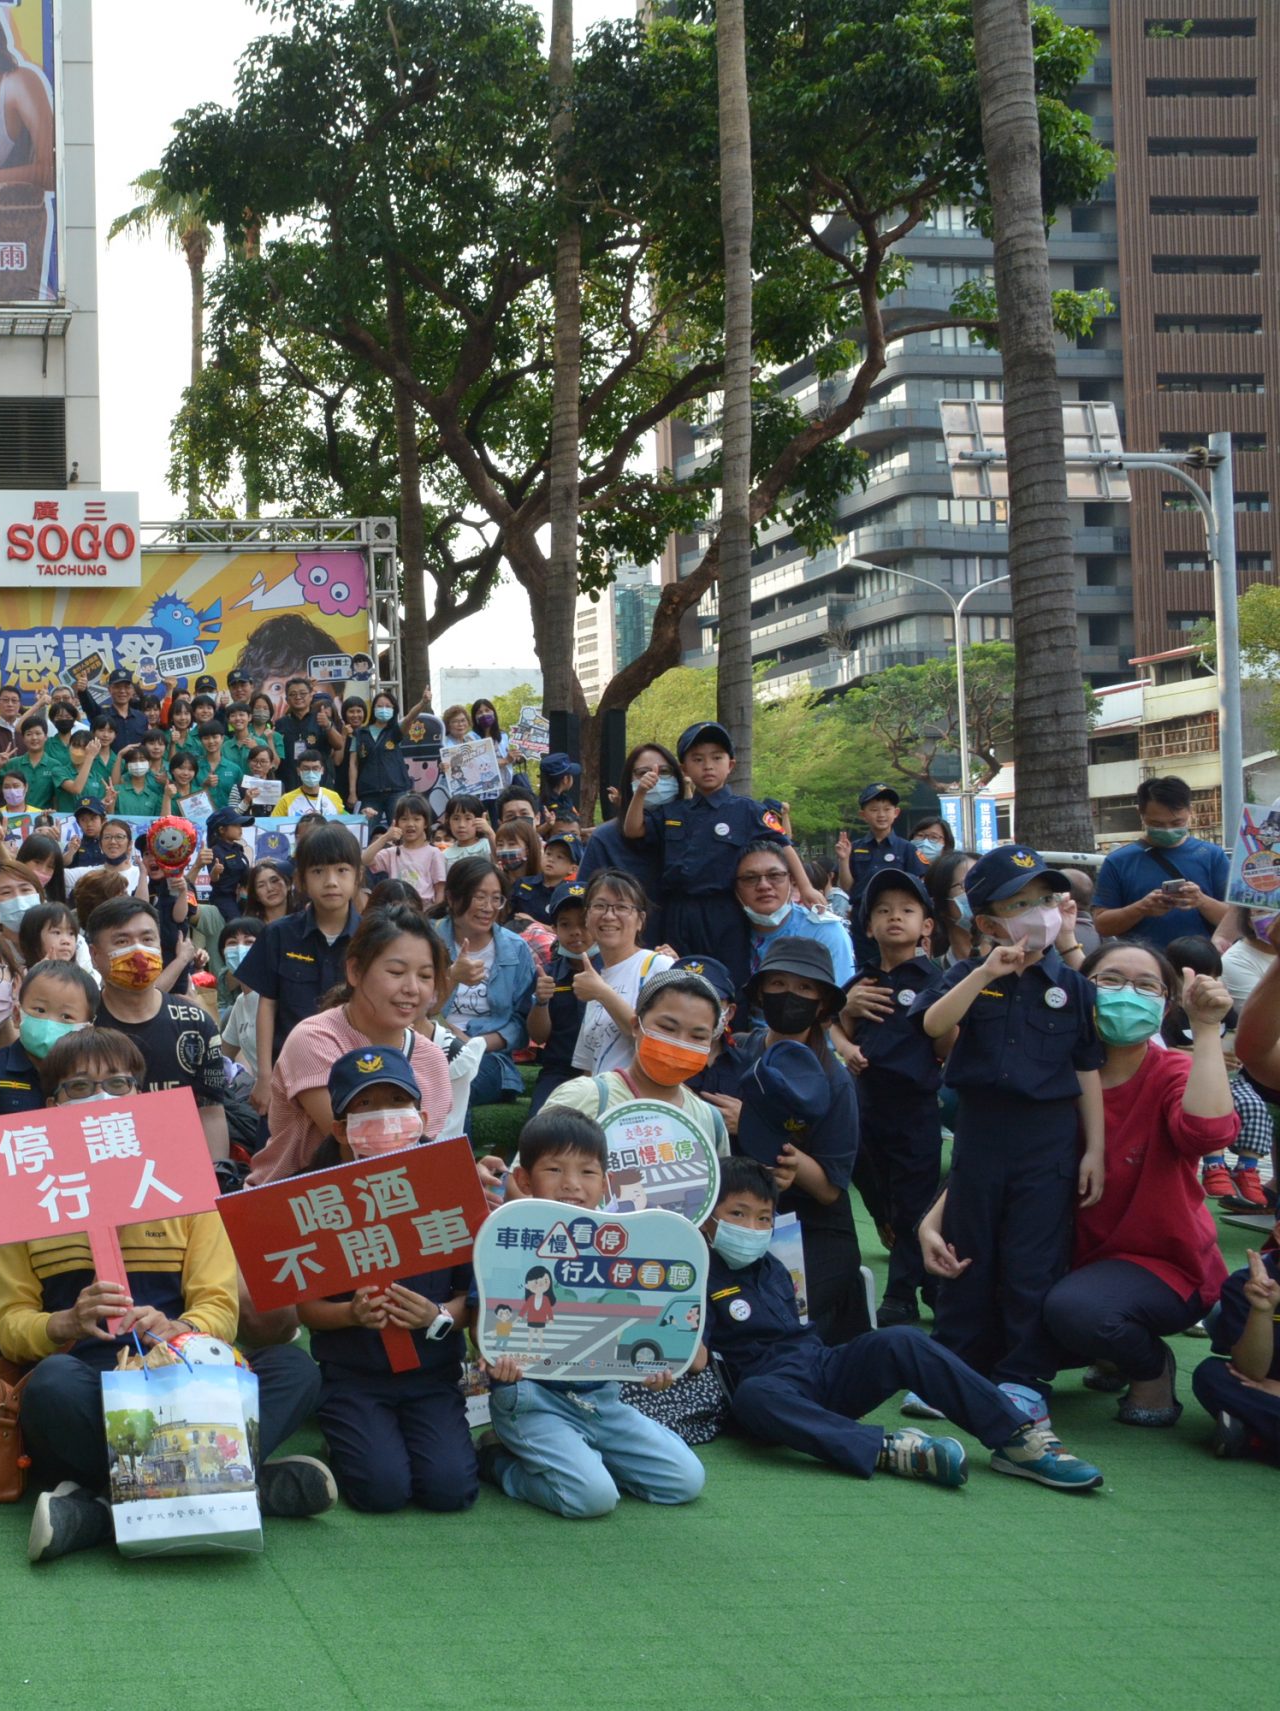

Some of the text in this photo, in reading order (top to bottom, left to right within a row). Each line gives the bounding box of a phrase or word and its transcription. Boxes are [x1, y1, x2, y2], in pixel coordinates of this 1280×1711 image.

[32, 501, 108, 521] 廣三
[7, 523, 135, 561] SOGO
[36, 564, 107, 576] TAICHUNG
[36, 1159, 183, 1223] 行人
[288, 1166, 419, 1237] 喝酒
[264, 1206, 474, 1291] 不開車
[496, 1223, 621, 1254] 車輛慢看停
[561, 1260, 691, 1287] 行人停看聽
